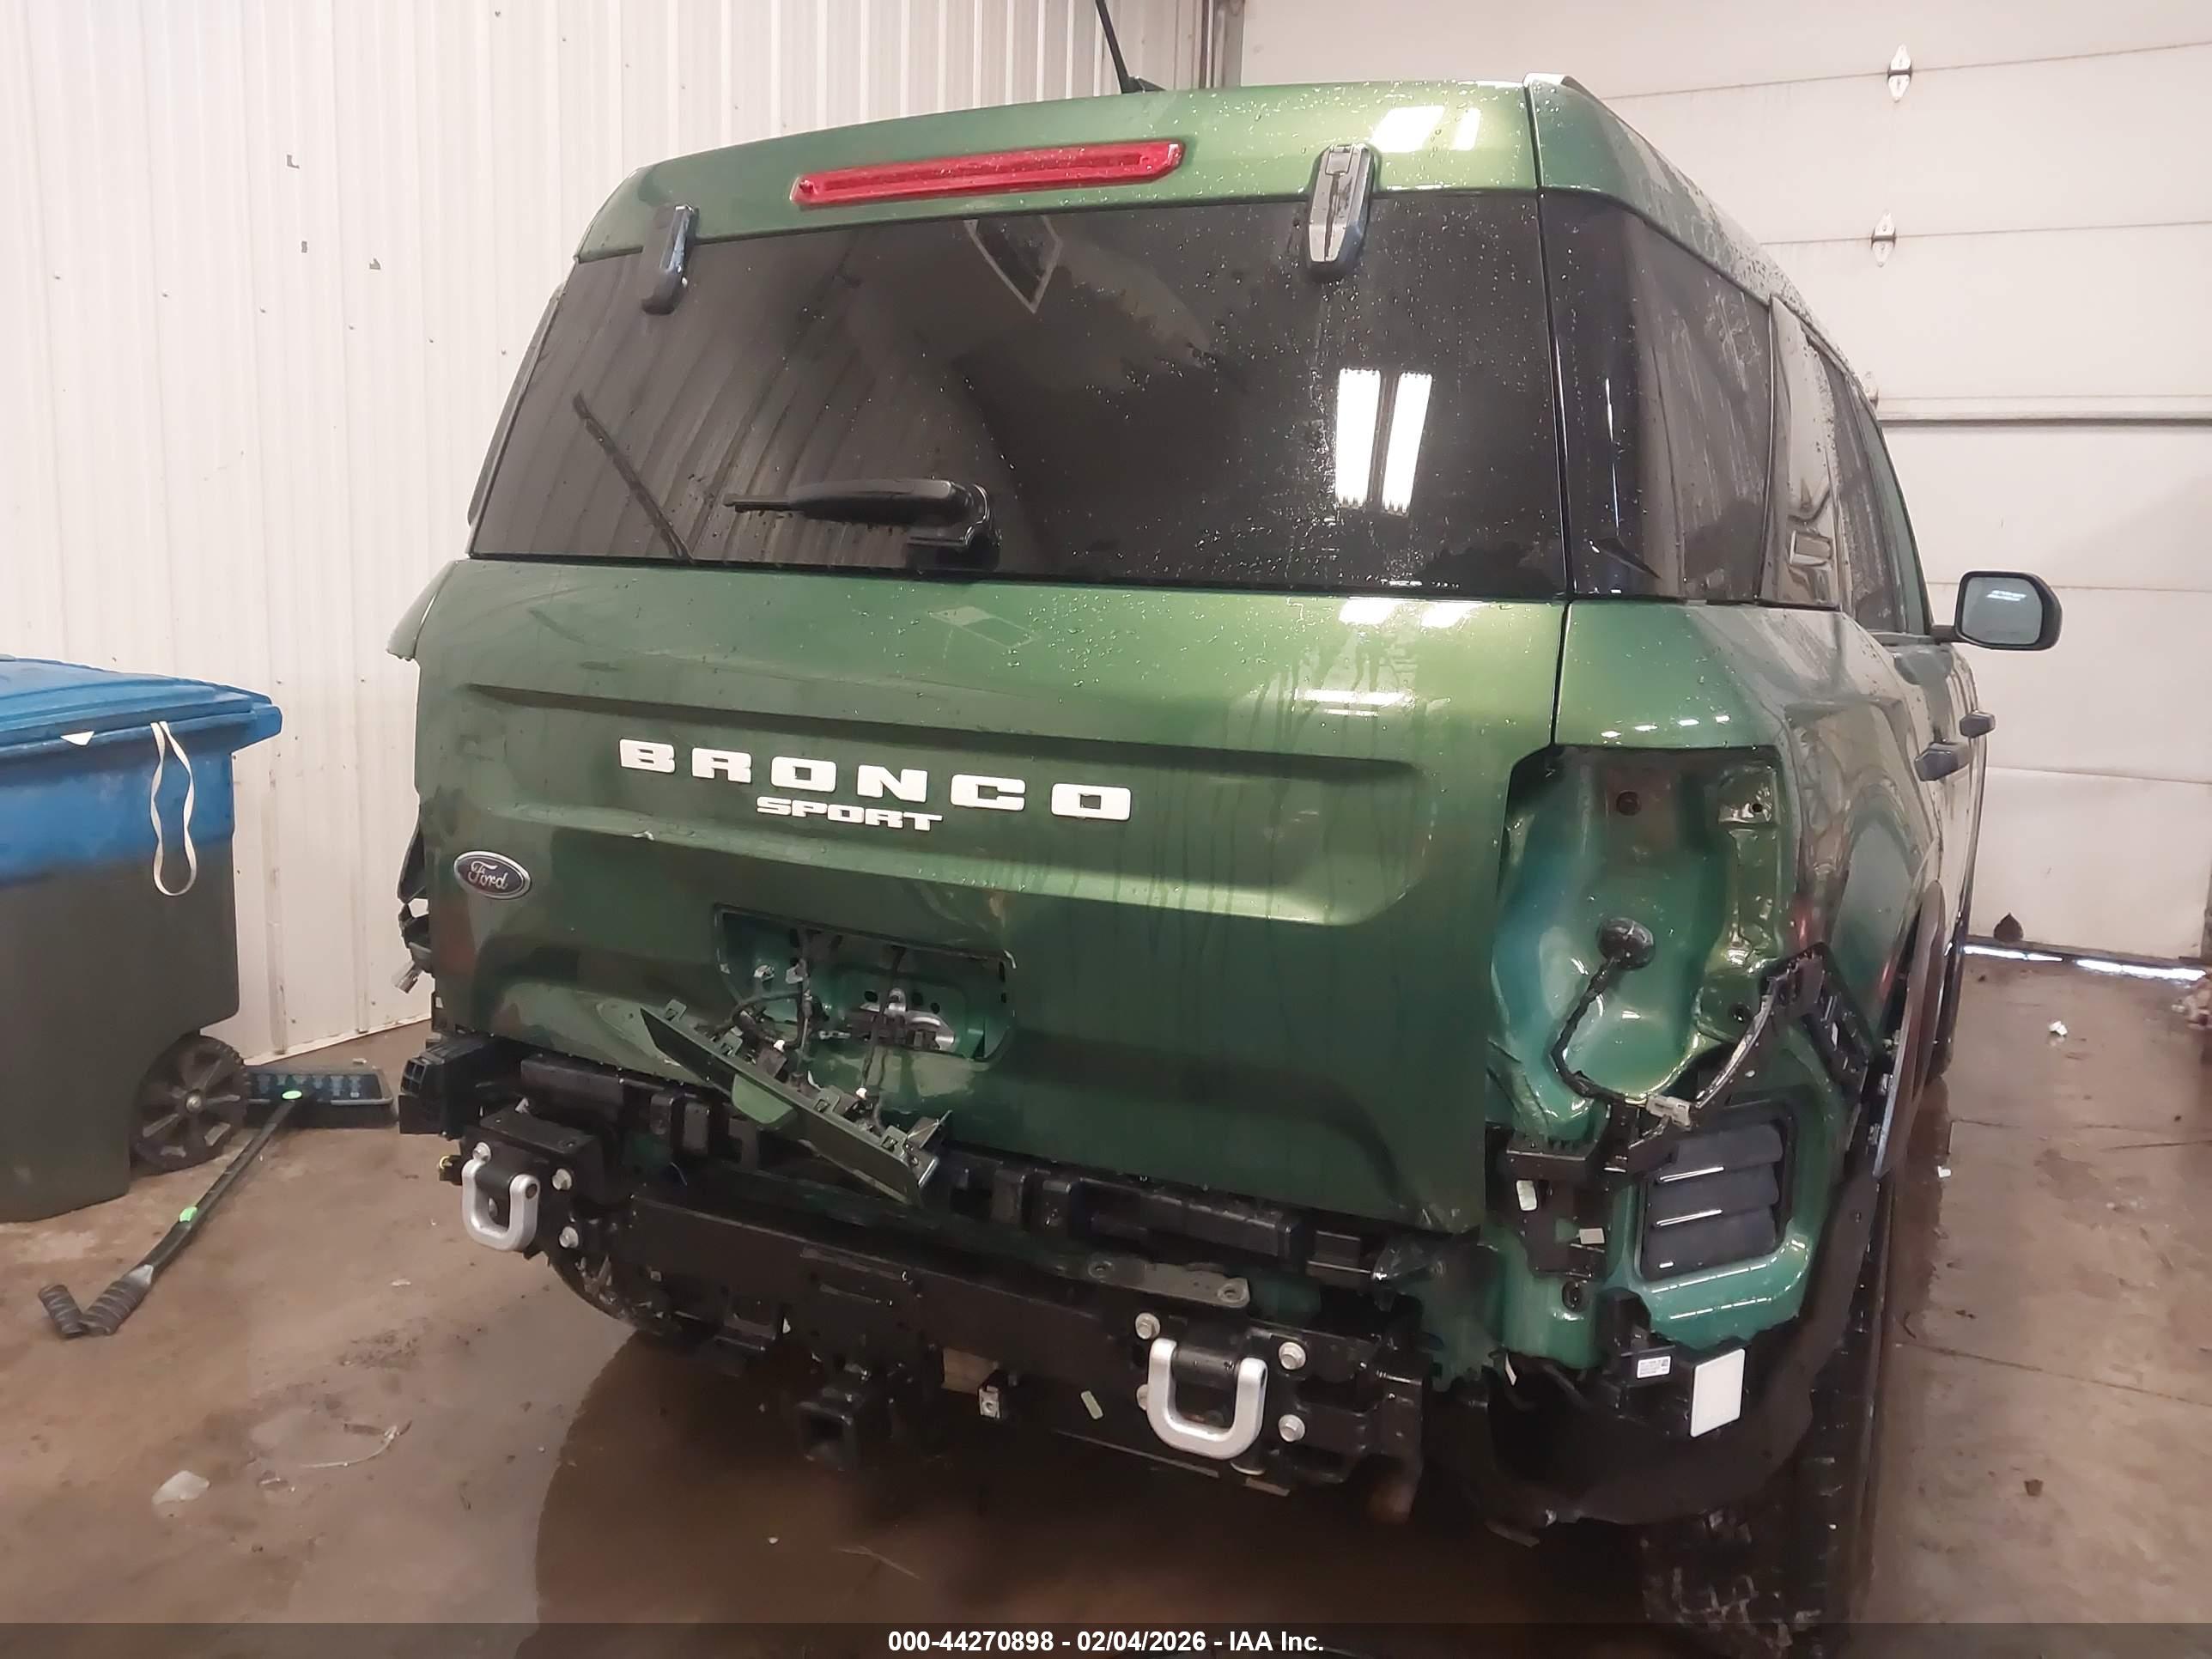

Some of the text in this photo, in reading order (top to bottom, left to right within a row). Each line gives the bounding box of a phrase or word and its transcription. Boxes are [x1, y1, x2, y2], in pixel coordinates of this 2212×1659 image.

[619, 738, 1132, 821] BRONCO
[757, 796, 943, 831] SPORT
[468, 860, 508, 890] Ford
